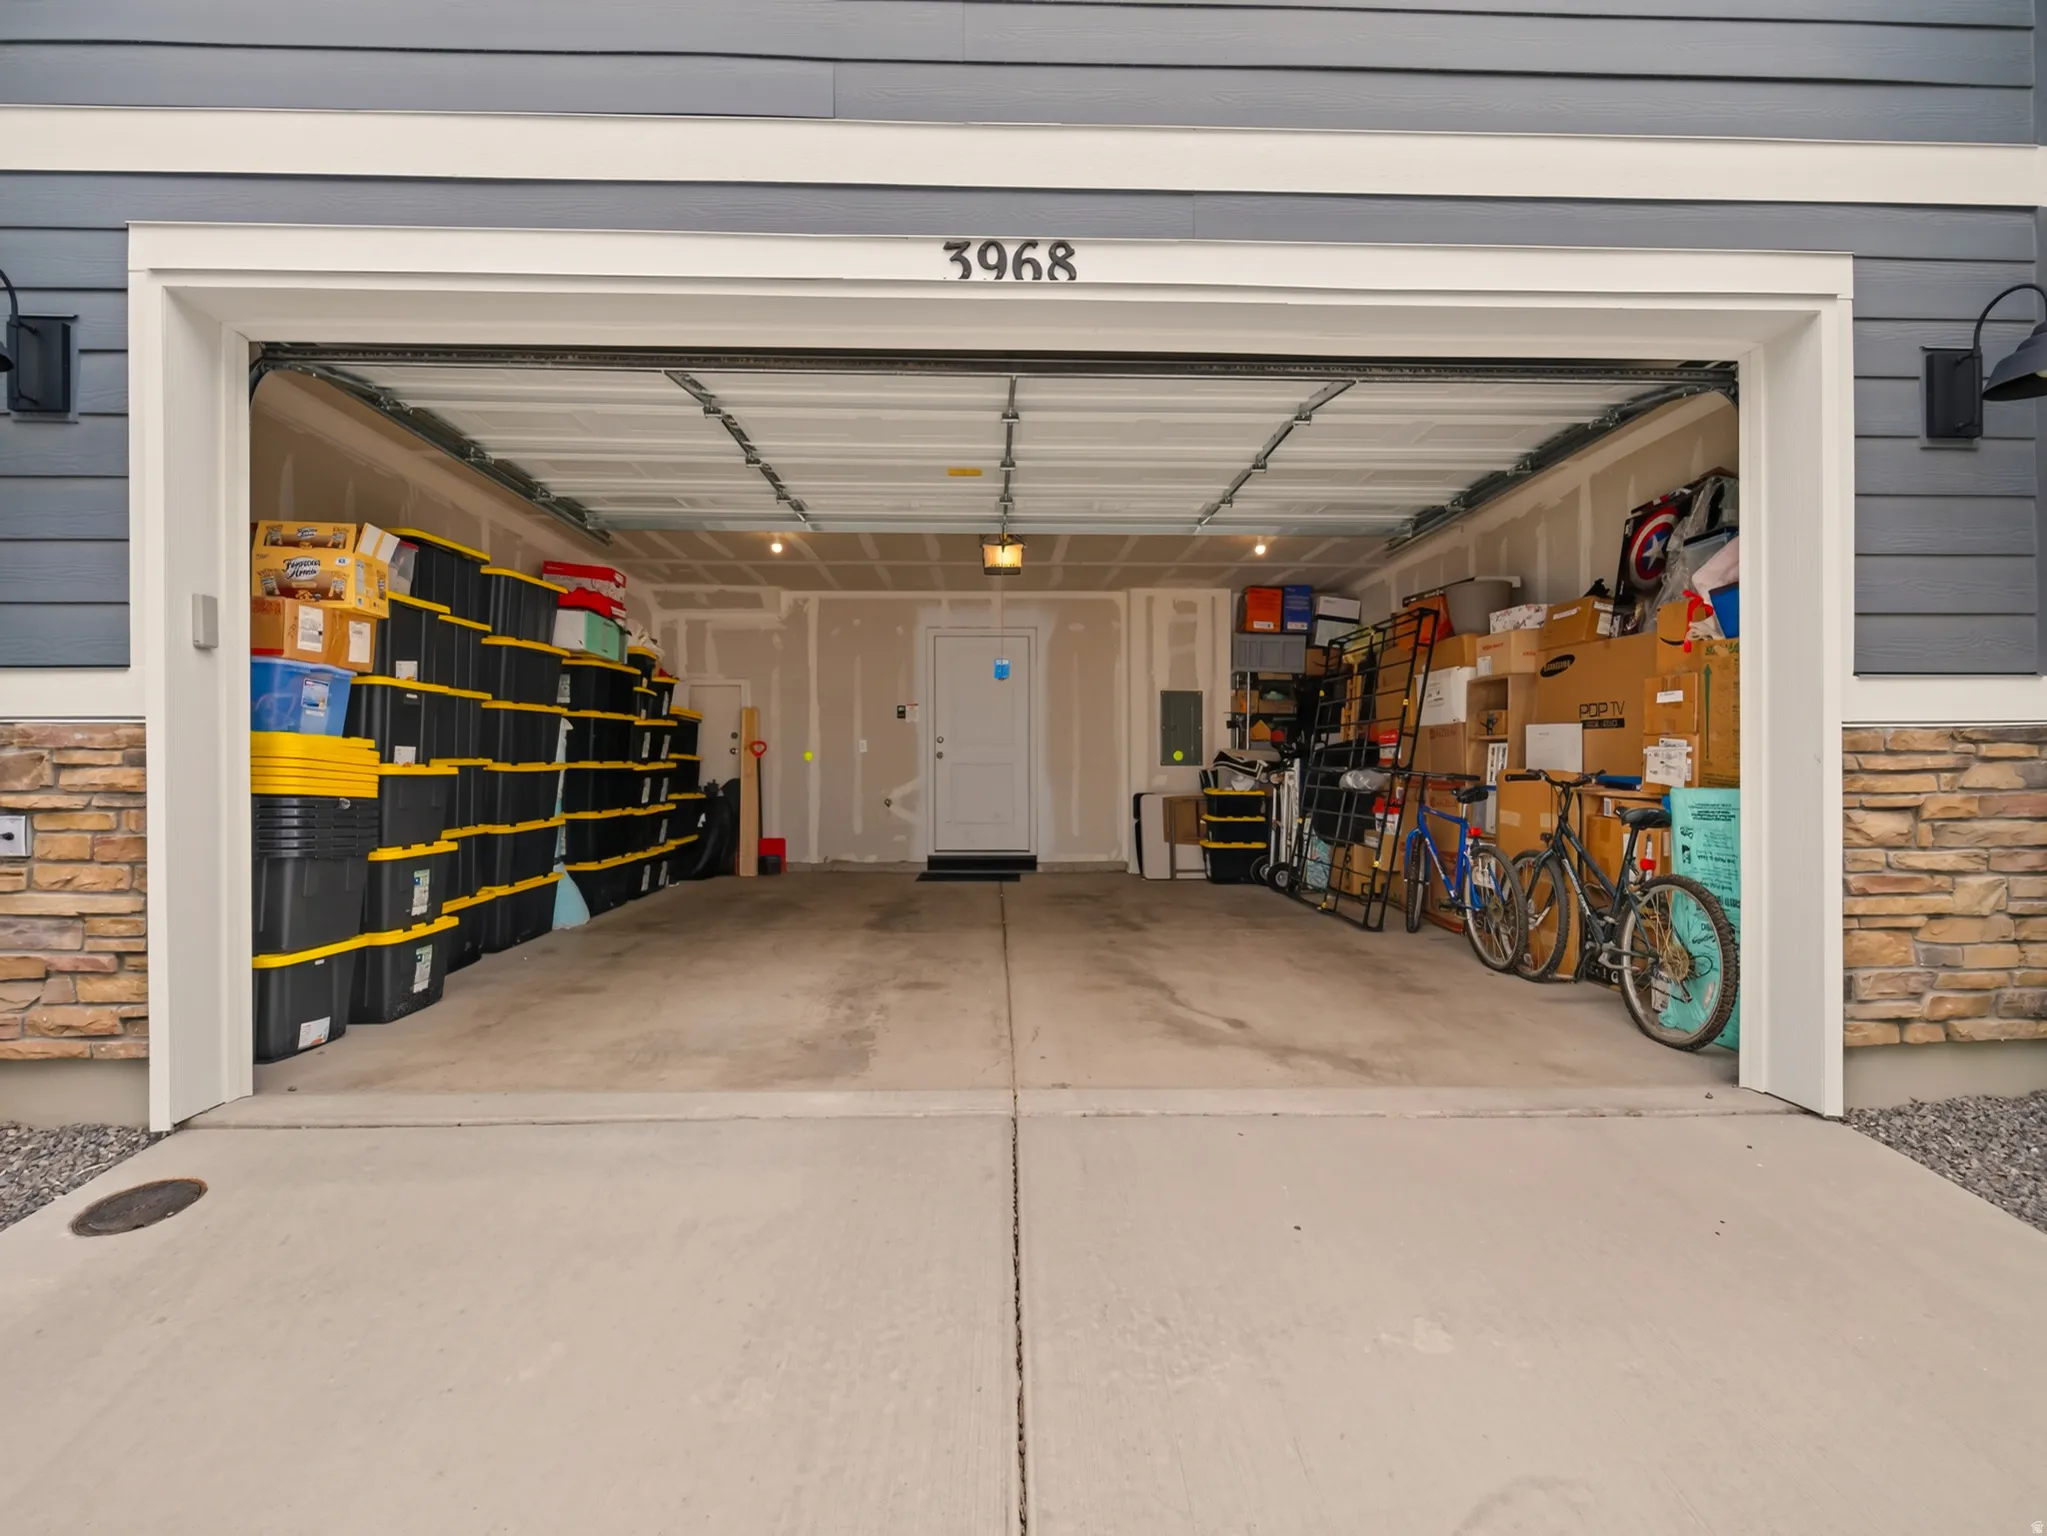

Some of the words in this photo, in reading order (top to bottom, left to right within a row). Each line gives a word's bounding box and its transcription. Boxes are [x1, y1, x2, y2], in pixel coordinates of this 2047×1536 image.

[943, 240, 1077, 281] 3968
[1579, 702, 1608, 719] POP
[1610, 701, 1625, 716] TV
